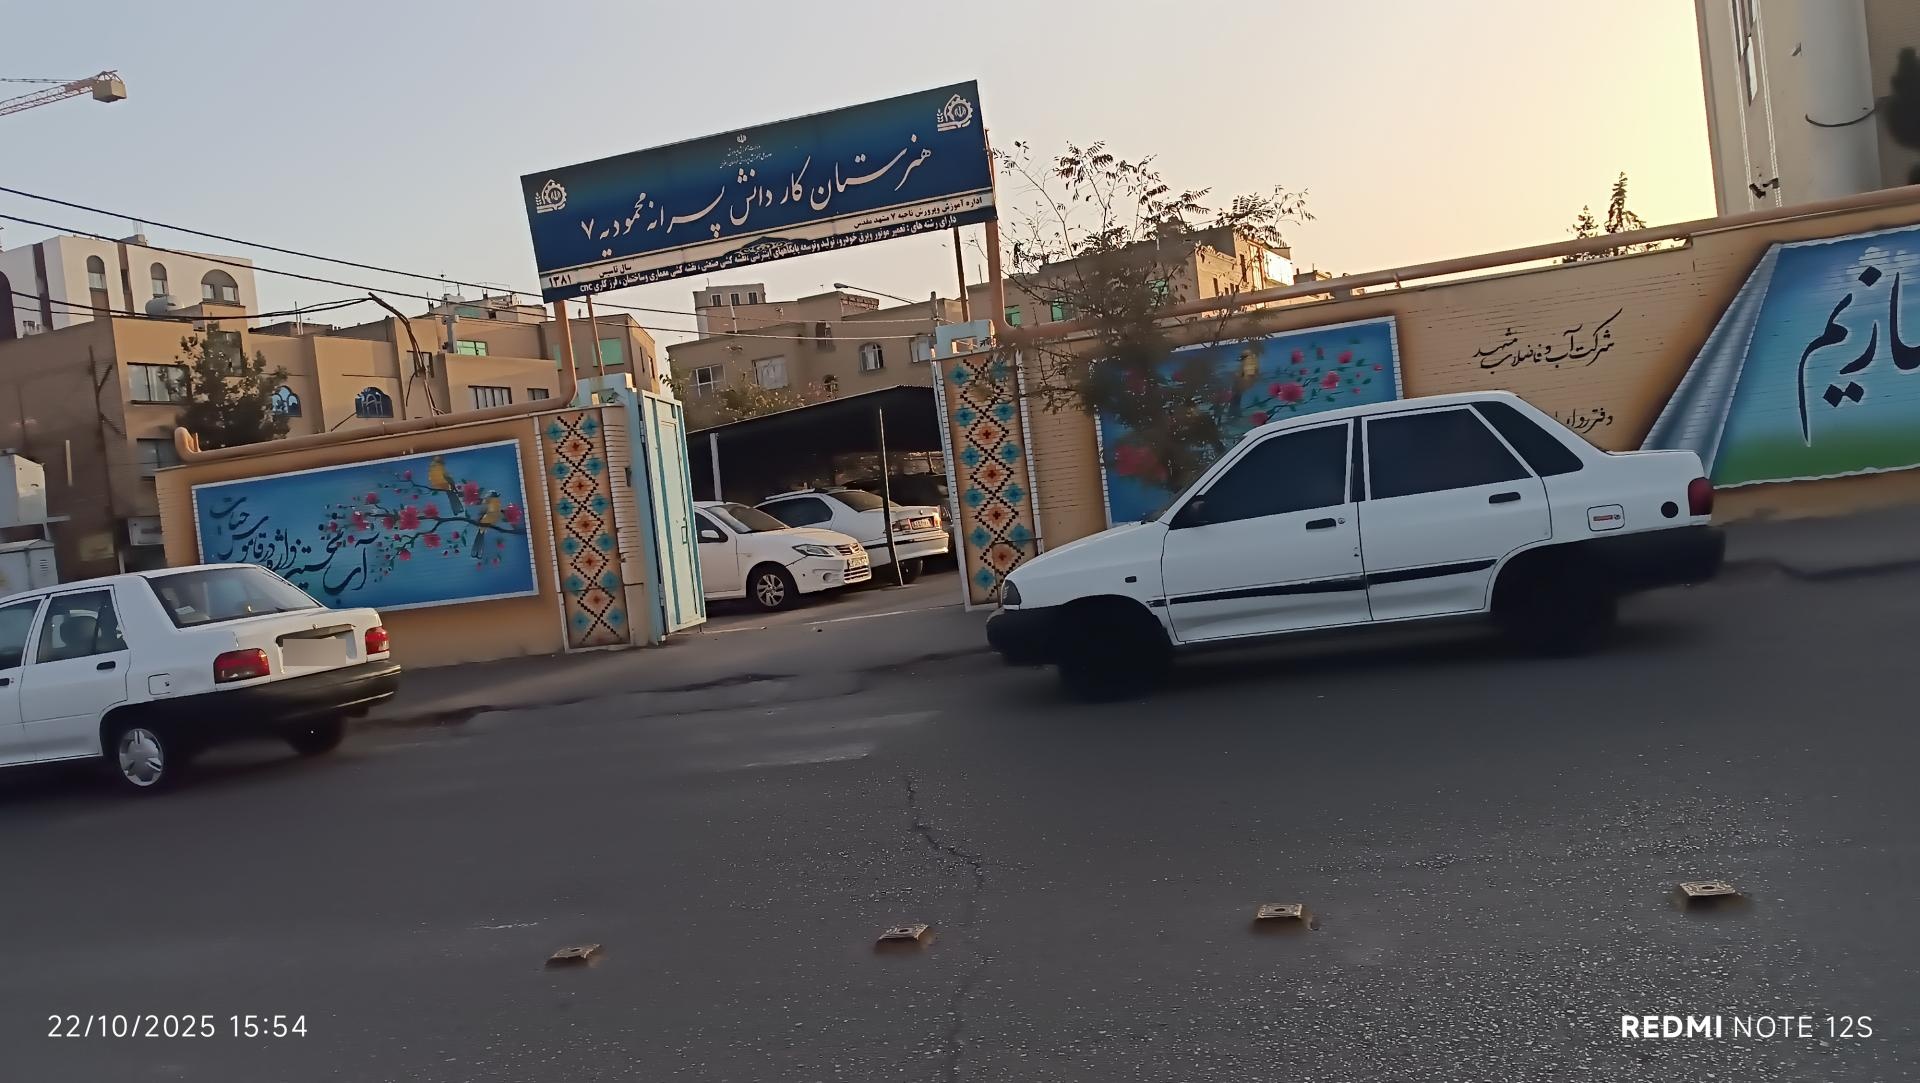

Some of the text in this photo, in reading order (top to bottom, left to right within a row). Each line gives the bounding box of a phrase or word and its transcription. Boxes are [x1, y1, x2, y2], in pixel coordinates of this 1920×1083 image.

[580, 133, 932, 258] هنرستان کار دانش پسرانه محمودیه ۷
[965, 196, 983, 208] اداره
[941, 198, 964, 213] آموزش
[873, 215, 890, 224] مشهد
[897, 209, 914, 219] ناحیه
[853, 218, 873, 230] مقدس
[923, 218, 939, 230] رشته
[939, 214, 957, 229] دارای
[874, 227, 890, 241] موتور
[891, 223, 906, 238] تعمیر
[820, 236, 836, 249] تولید
[619, 263, 632, 275] سال
[684, 262, 697, 272] نقشه
[719, 255, 733, 269] کشی
[648, 269, 670, 282] معماری
[669, 264, 683, 278] کشی
[548, 274, 572, 289] ۱۳۸۱
[579, 283, 593, 293] cnc
[593, 279, 607, 292] کاری
[609, 277, 618, 290] فرز
[1472, 327, 1518, 358] مشهد
[1569, 307, 1623, 366] شرکت
[1545, 323, 1584, 368] آب
[1480, 344, 1545, 375] فاضلاب
[1583, 408, 1614, 434] دفتر
[322, 533, 380, 605] آب
